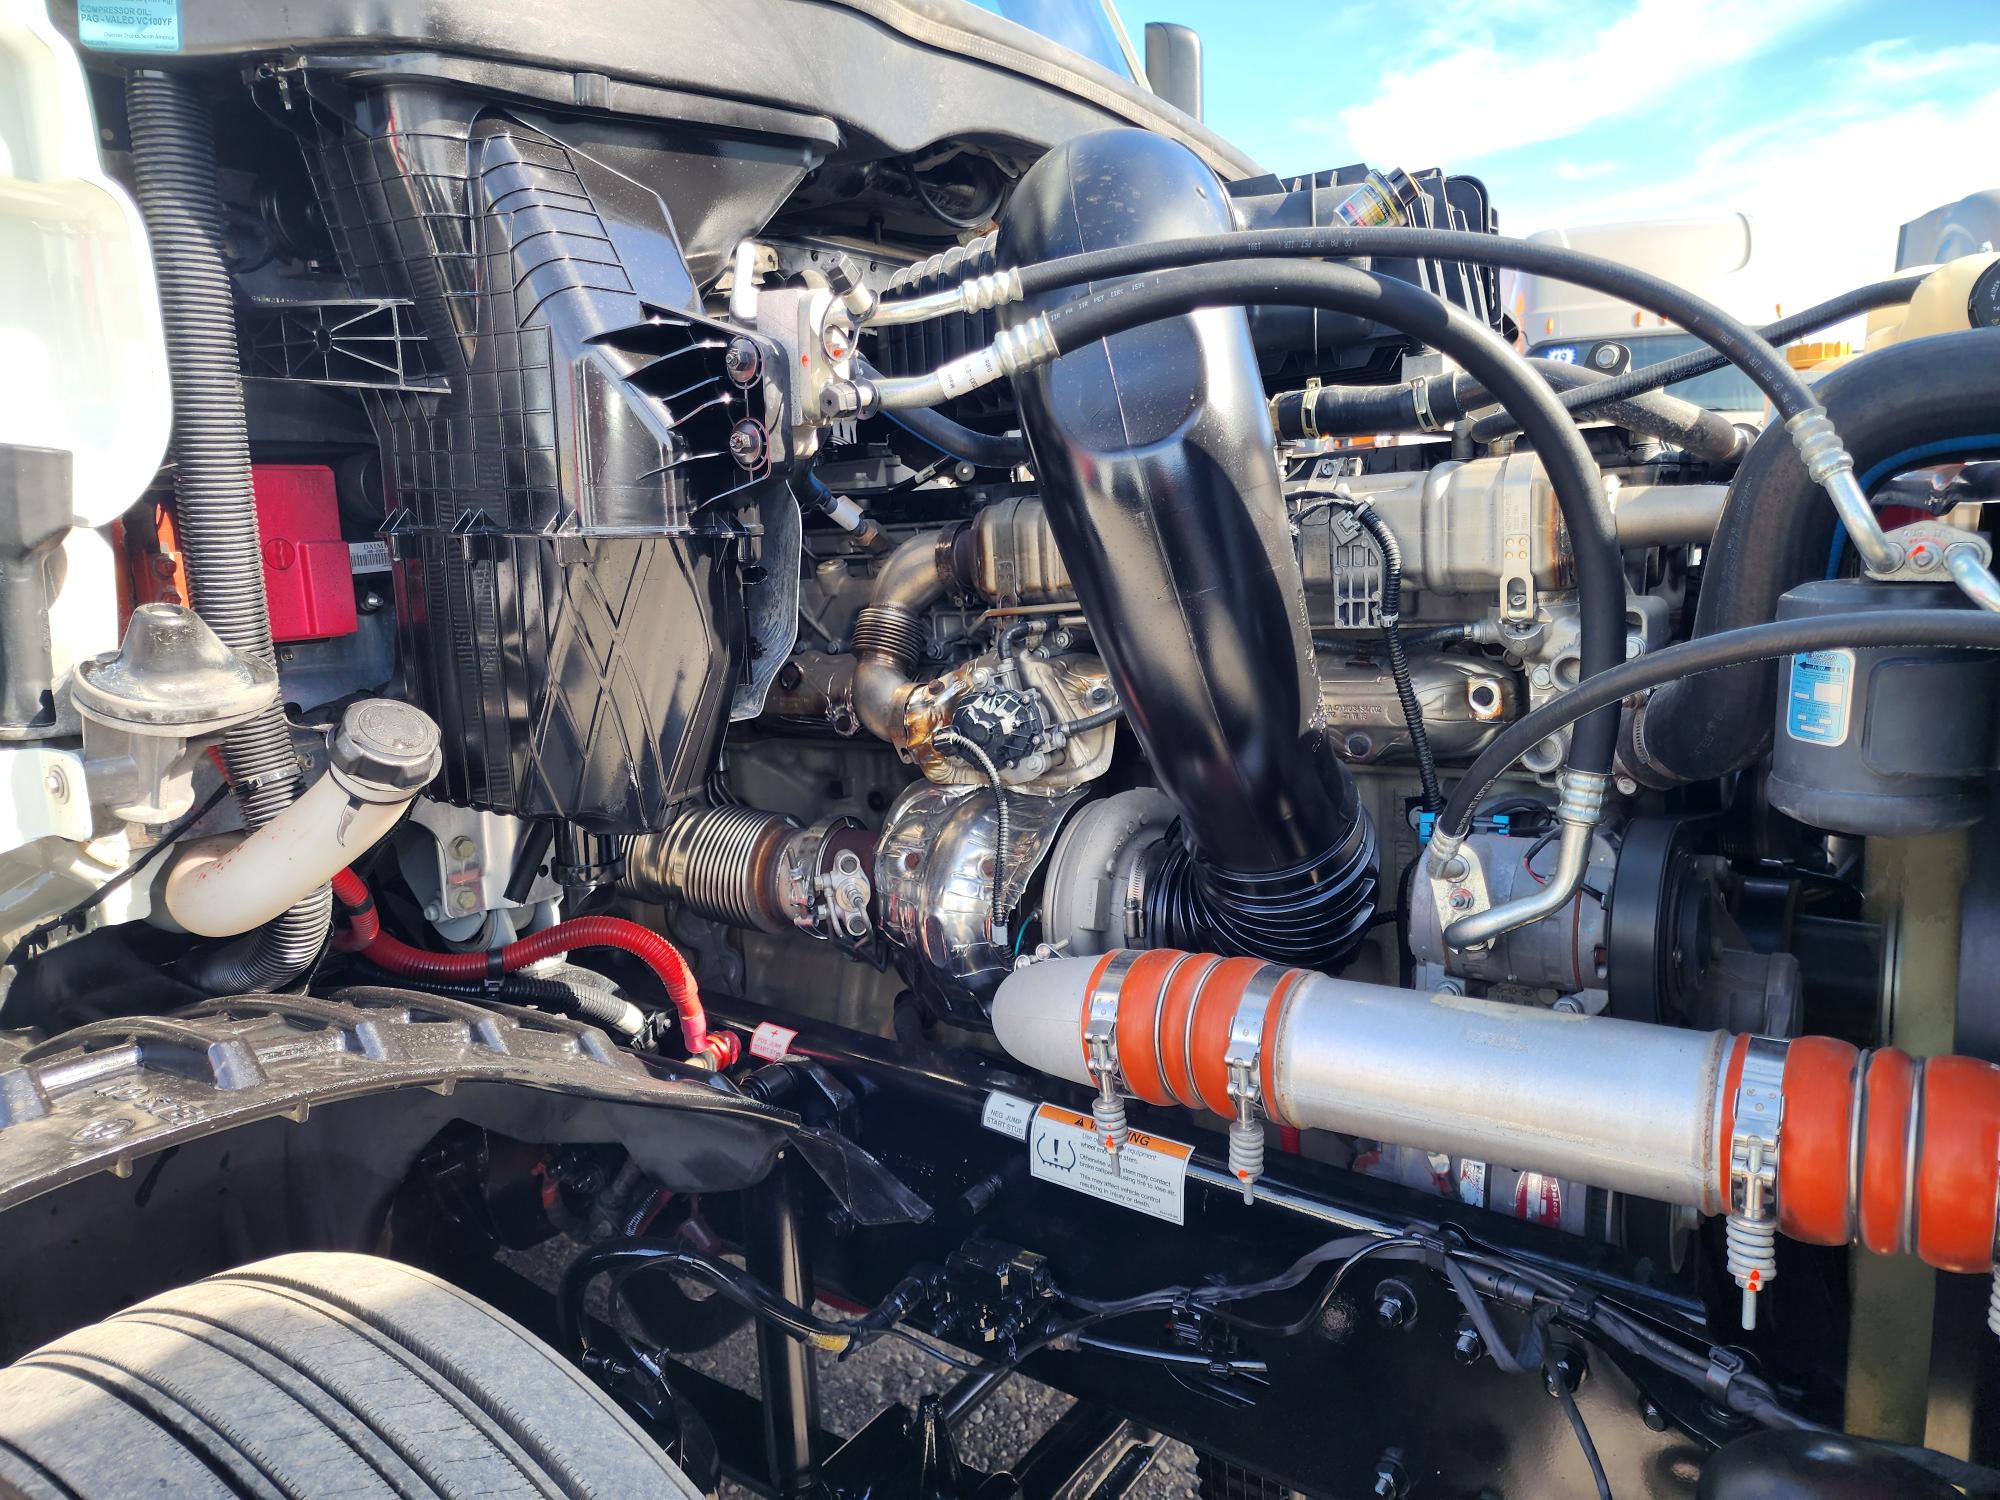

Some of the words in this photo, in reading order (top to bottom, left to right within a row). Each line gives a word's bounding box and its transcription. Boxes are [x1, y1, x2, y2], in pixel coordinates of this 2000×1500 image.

[80, 6, 135, 16] COMPRESSOR
[136, 8, 152, 16] OIL:
[81, 13, 100, 22] PAG
[105, 15, 134, 25] VALEO
[136, 17, 172, 26] VC100YF
[986, 1116, 1006, 1128] START
[1007, 1124, 1024, 1134] STUD
[990, 1110, 1004, 1119] NEG
[1006, 1114, 1022, 1124] JUMP
[1080, 1142, 1096, 1152] wheel
[1080, 1161, 1094, 1170] brake
[1080, 1154, 1106, 1168] Otherwise
[1136, 1172, 1149, 1180] may
[1149, 1176, 1171, 1187] contact
[1080, 1172, 1091, 1182] This
[1091, 1177, 1104, 1186] may
[1104, 1180, 1120, 1190] affect
[1120, 1186, 1140, 1196] vehicle
[1140, 1192, 1161, 1204] control
[1080, 1181, 1103, 1194] resulting
[1110, 1190, 1126, 1201] injury
[1550, 1184, 1558, 1214] Delco
